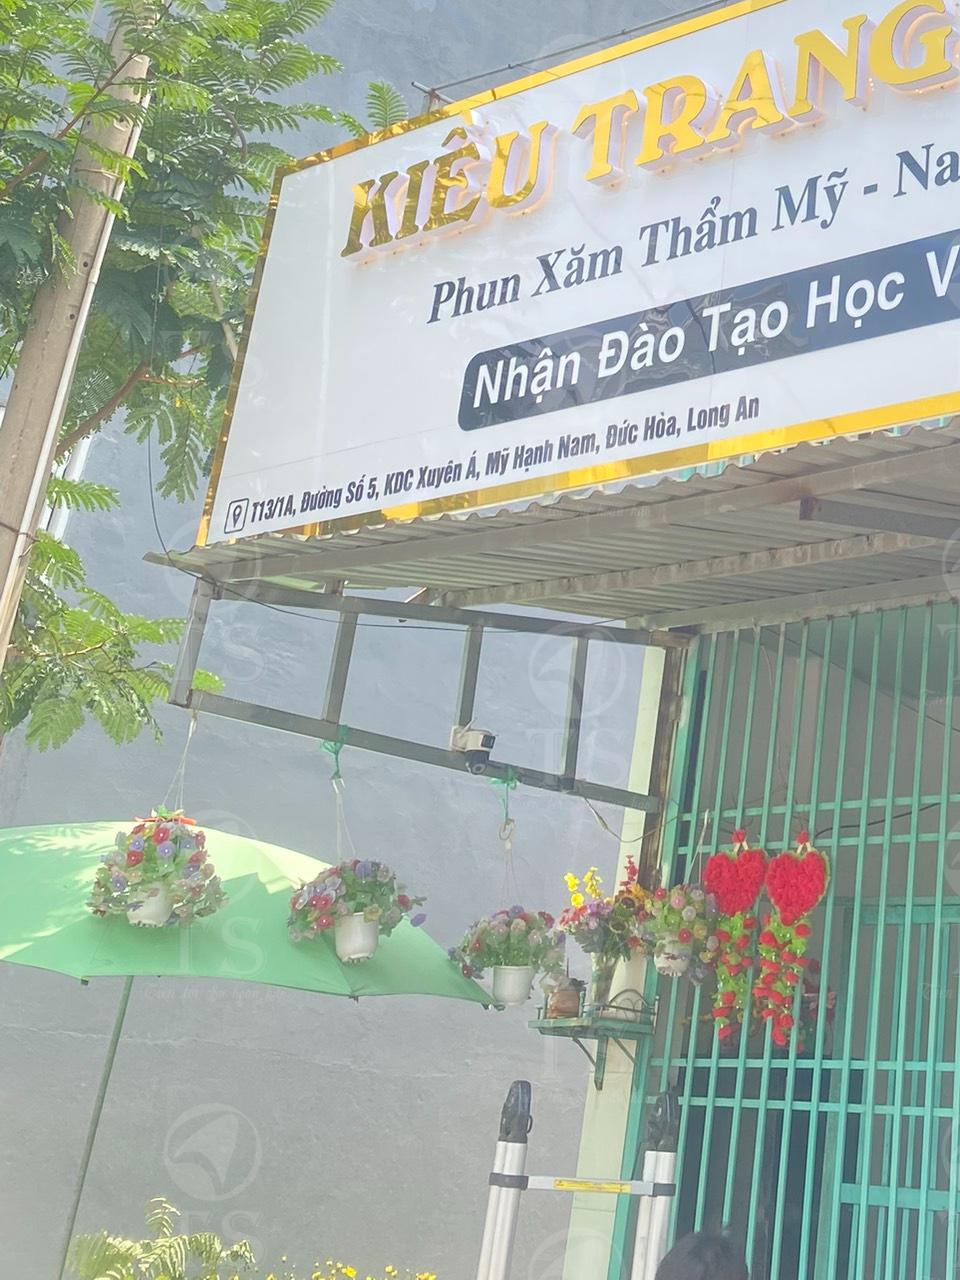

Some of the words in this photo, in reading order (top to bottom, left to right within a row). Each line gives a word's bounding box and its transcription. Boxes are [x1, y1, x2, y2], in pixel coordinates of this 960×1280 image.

[341, 109, 550, 258] KIỀU
[426, 274, 520, 324] Phun
[531, 243, 622, 297] Xăm
[639, 196, 758, 267] Thẩm
[771, 167, 849, 229] Mỹ
[473, 351, 580, 409] Nhận
[597, 324, 686, 379] Đào
[702, 297, 790, 356] Tạo
[805, 275, 905, 329] Học
[250, 494, 296, 523] T13/1A,
[300, 485, 343, 512] Đường
[346, 474, 366, 504] Số
[367, 477, 379, 501] 5,
[384, 469, 414, 496] KDC
[416, 460, 463, 489] Xuyên
[465, 450, 480, 480] Á,
[485, 447, 509, 476] Mỹ
[513, 439, 554, 472] Hạnh
[557, 431, 600, 459] Nam,
[605, 419, 638, 449] Đức
[643, 412, 681, 441] Hòa,
[687, 403, 730, 432] Long
[735, 395, 760, 421] An
